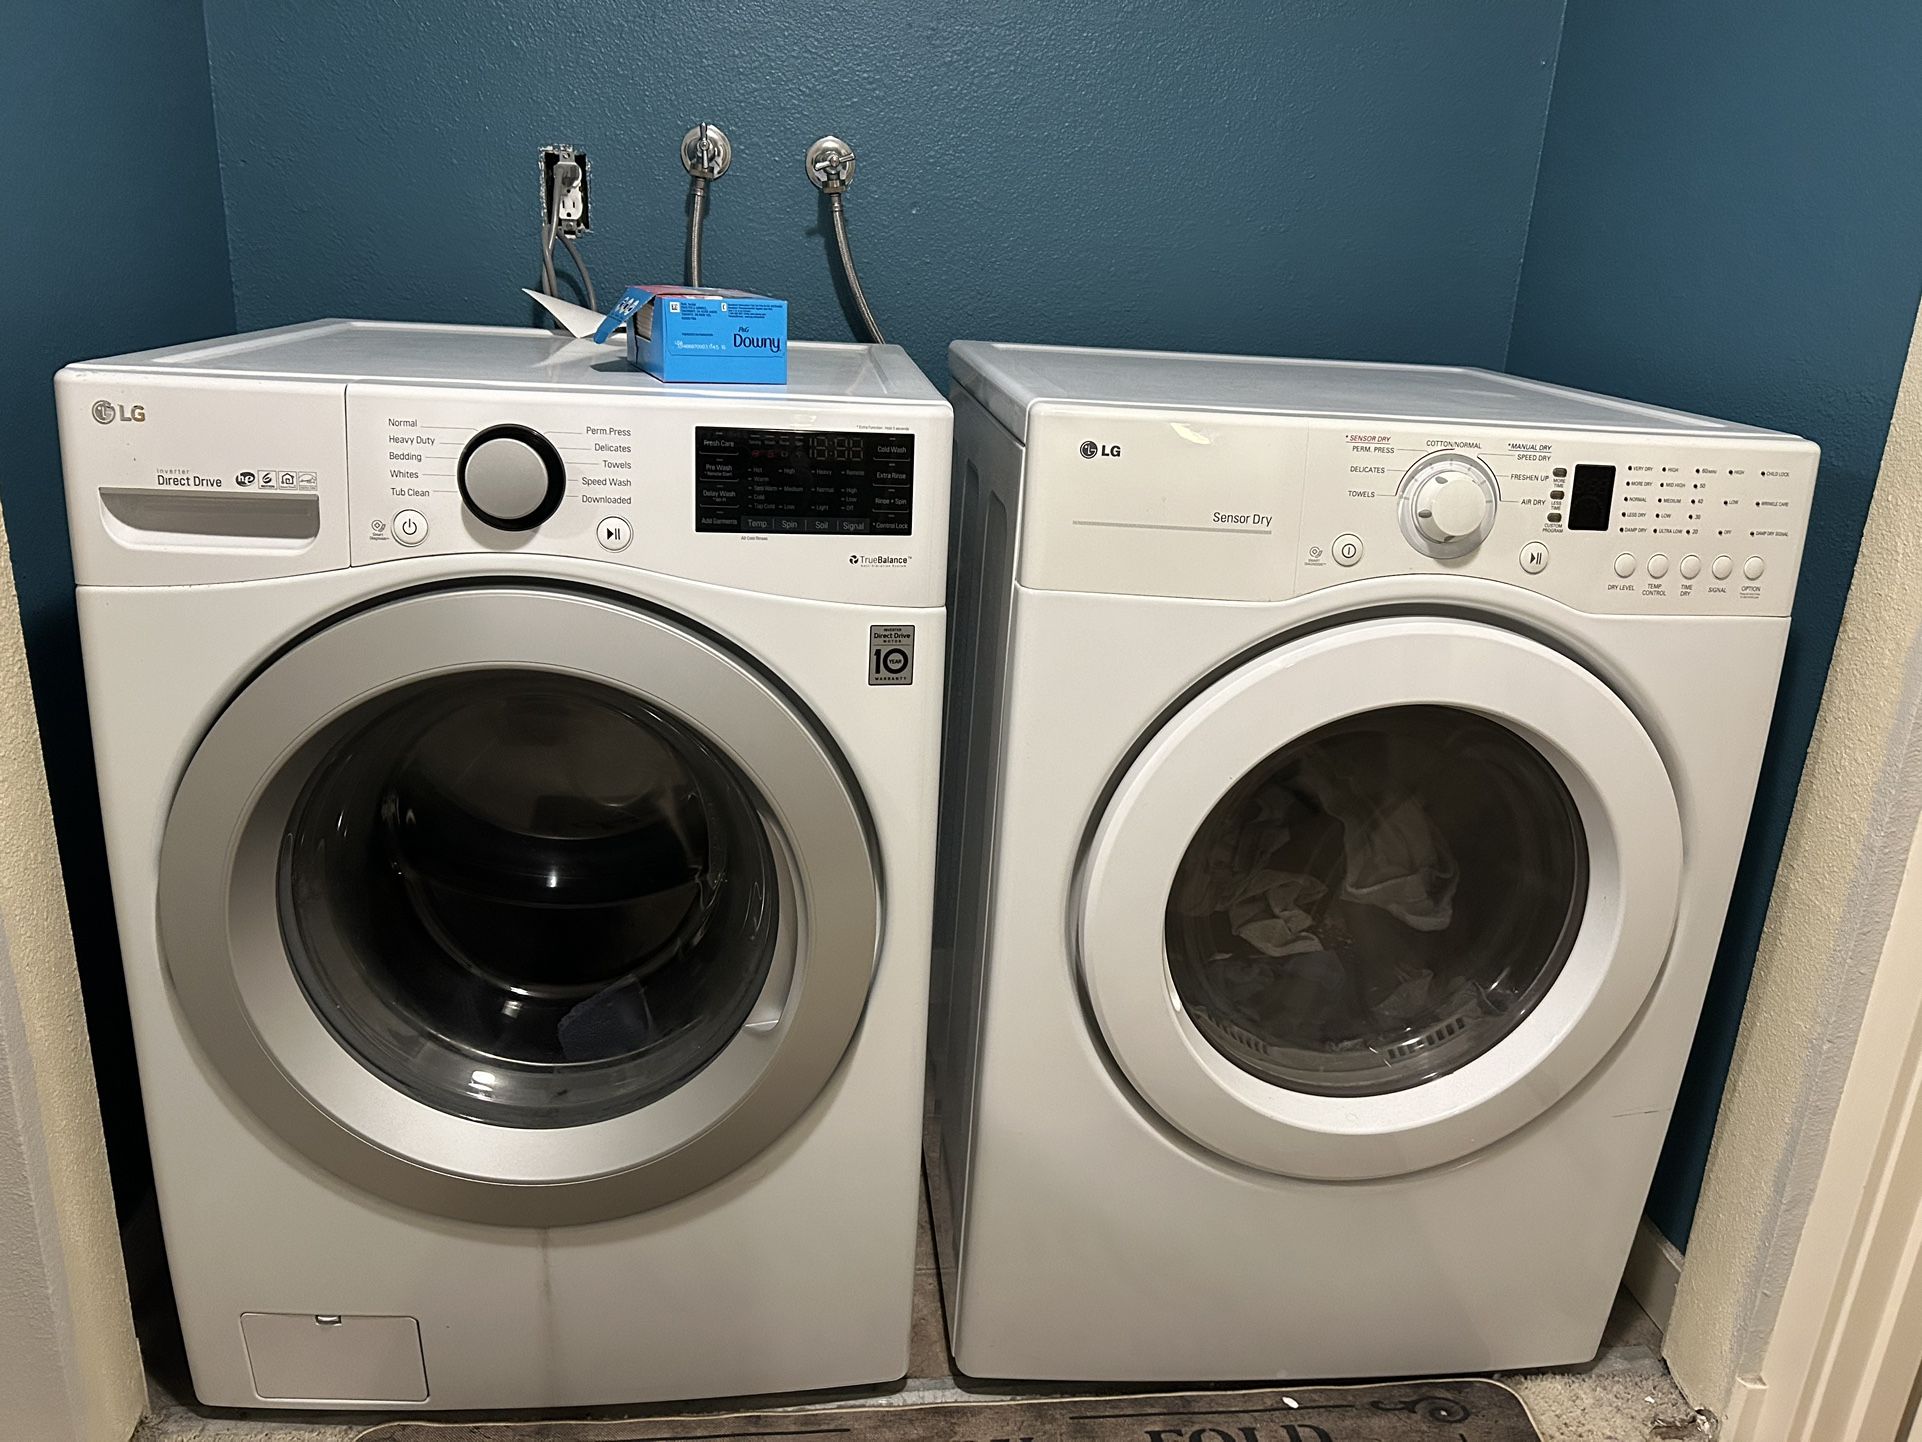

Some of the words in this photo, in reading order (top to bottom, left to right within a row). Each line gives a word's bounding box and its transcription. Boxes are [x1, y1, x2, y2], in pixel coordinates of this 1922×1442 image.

[734, 334, 781, 353] Downy
[388, 418, 417, 427] Normal
[389, 435, 414, 445] Heavy
[416, 436, 435, 445] Duty
[1426, 440, 1482, 449] COTTON/NORMAL
[595, 443, 631, 452] Delicates
[1102, 445, 1121, 458] LG
[389, 452, 422, 462] Bedding
[603, 460, 631, 469] Towels
[390, 470, 418, 478] Whites
[158, 474, 190, 487] Direct
[194, 476, 222, 487] Drive
[582, 477, 607, 486] Speed
[609, 478, 631, 486] Wash
[391, 488, 405, 496] Tub
[408, 488, 430, 496] Clean
[1348, 490, 1375, 498] TOWELS
[582, 495, 631, 504] Downloaded
[748, 520, 768, 528] Temp
[782, 520, 797, 528] Spin
[1212, 512, 1250, 525] Sensor
[1252, 514, 1272, 527] Dry
[843, 522, 864, 530] Signal
[874, 648, 908, 674] 10
